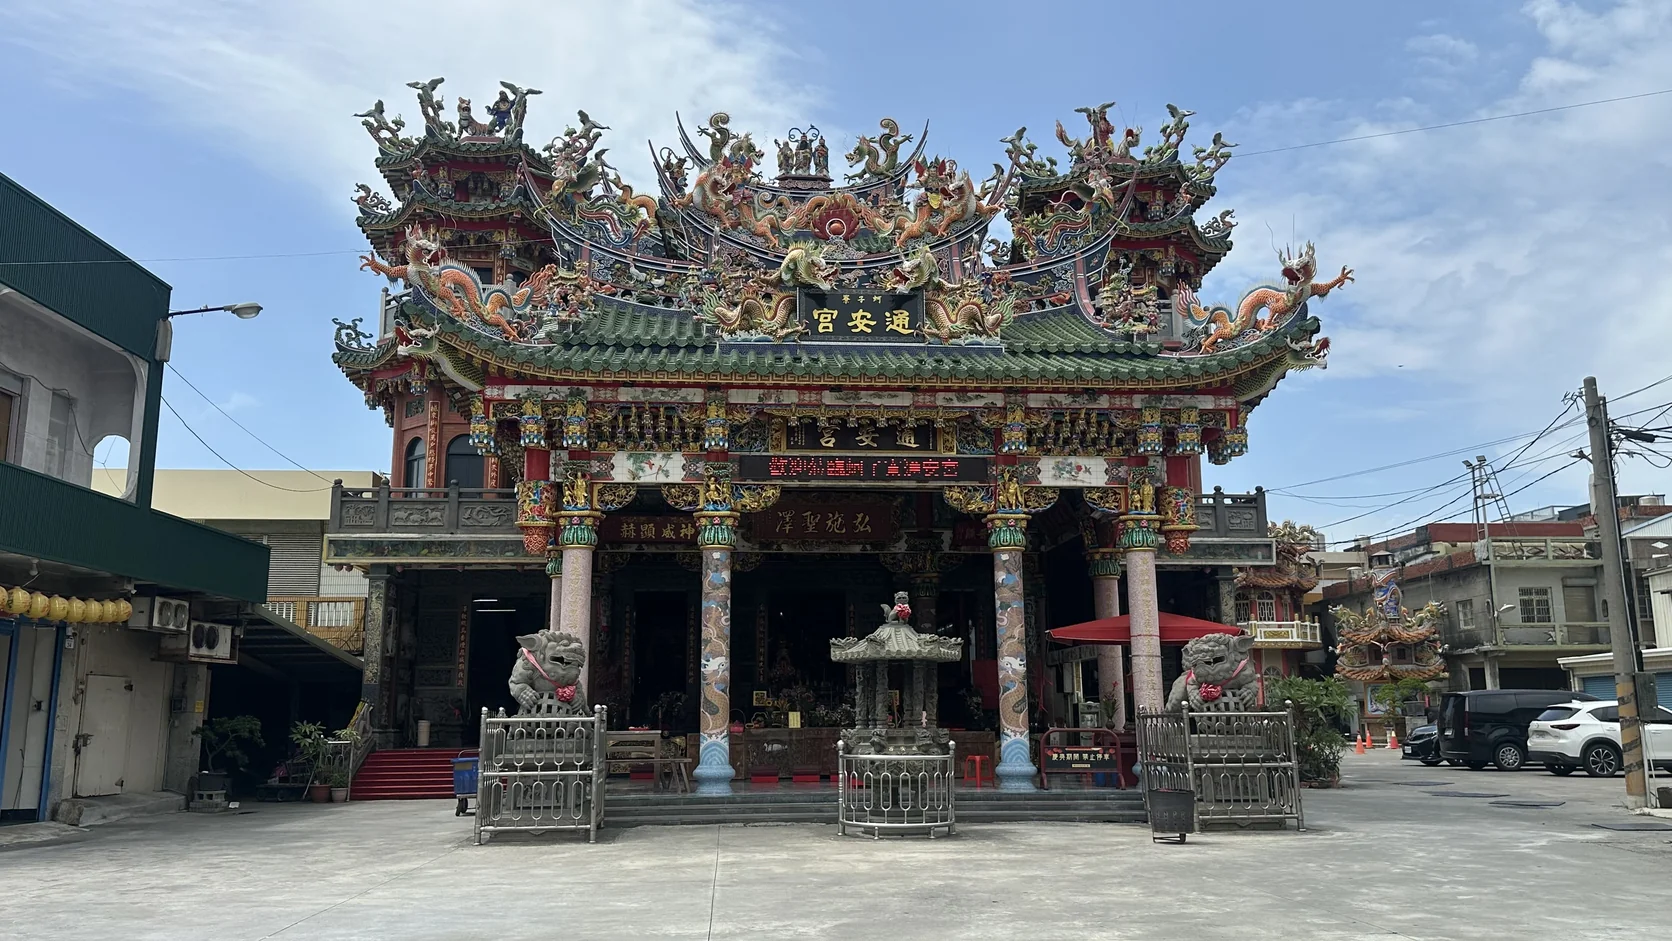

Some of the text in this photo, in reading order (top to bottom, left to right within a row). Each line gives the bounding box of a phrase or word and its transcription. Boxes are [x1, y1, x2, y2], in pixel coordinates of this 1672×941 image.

[841, 294, 882, 304] 蚵子寮
[812, 307, 915, 335] 通安宮
[818, 422, 920, 448] 通安宮
[775, 509, 872, 534] 弘施聖澤
[1082, 753, 1110, 761] 禁止停車
